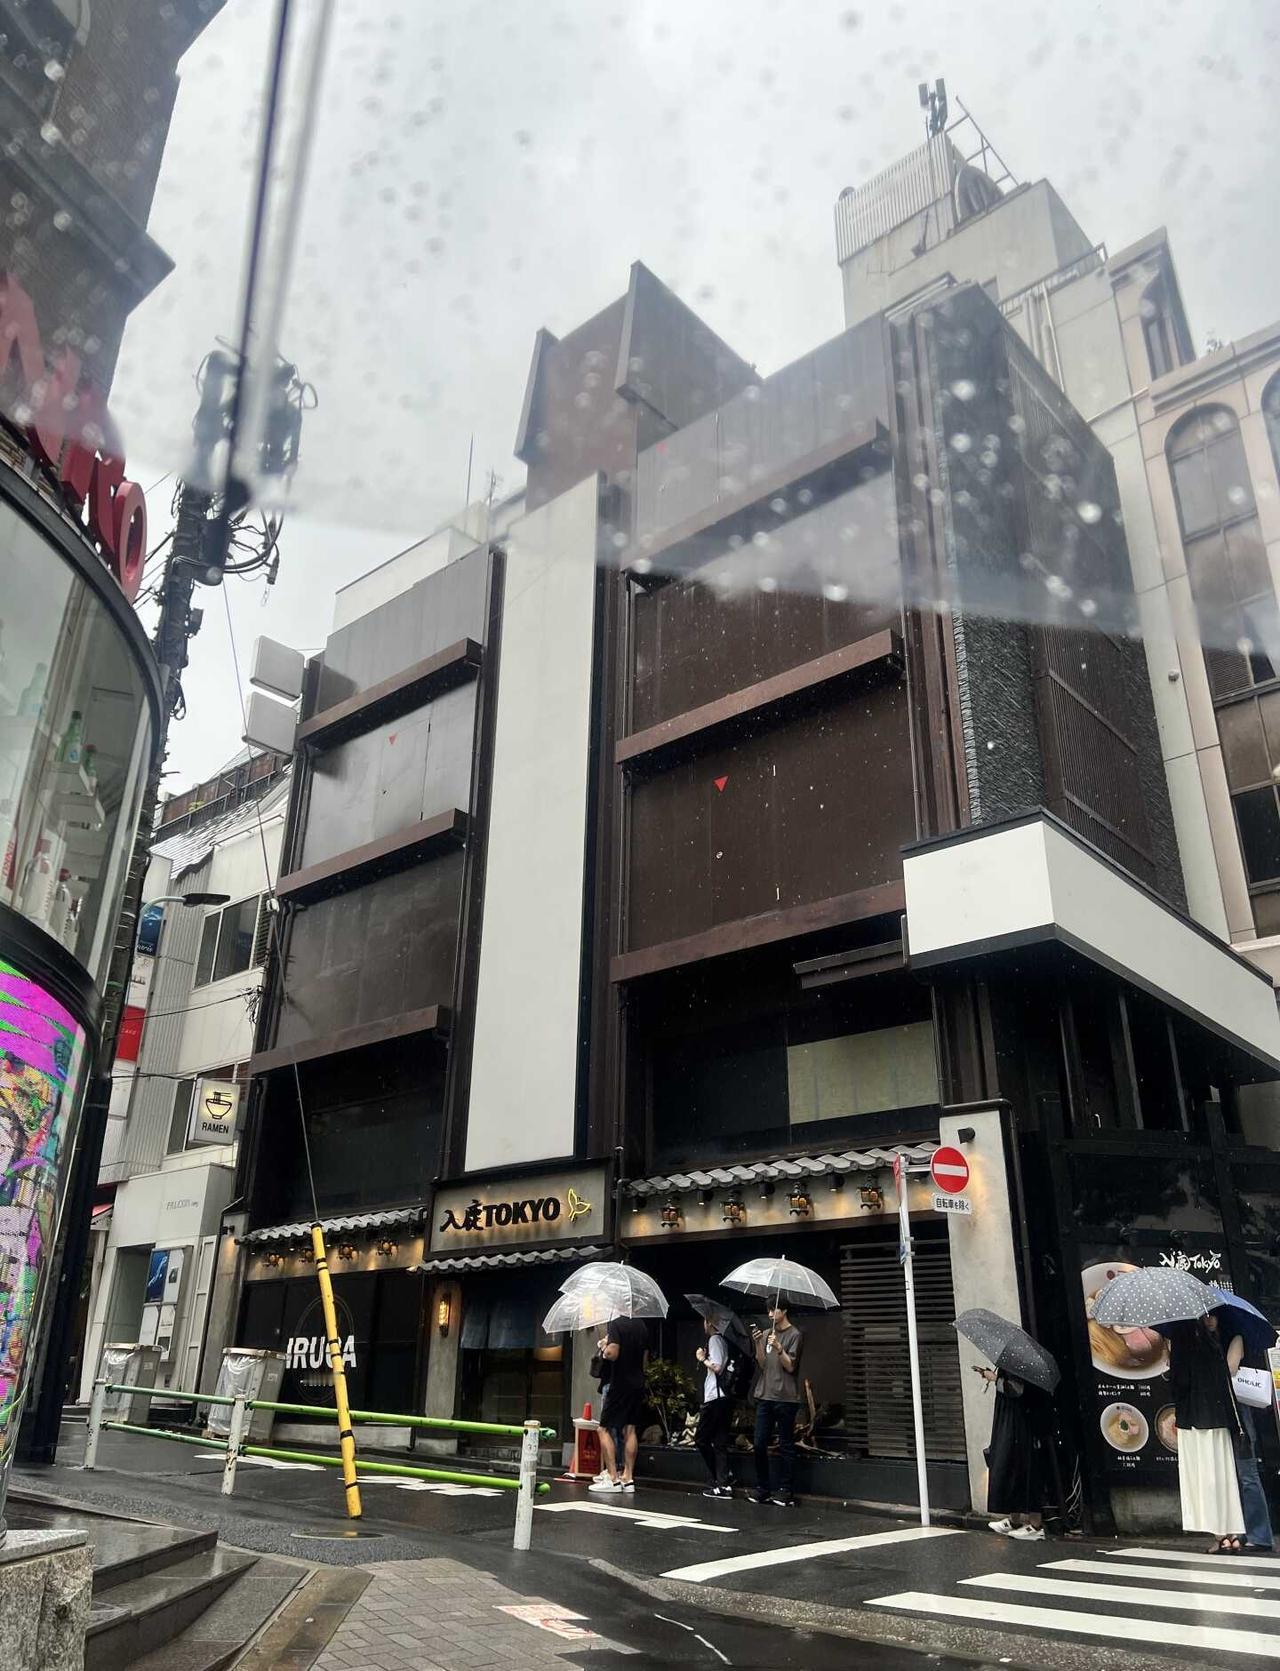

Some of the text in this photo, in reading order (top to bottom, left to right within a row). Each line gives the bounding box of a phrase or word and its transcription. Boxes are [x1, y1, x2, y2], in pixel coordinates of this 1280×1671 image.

[201, 1121, 229, 1134] RAMEN
[936, 1198, 969, 1211] 自転車を除く
